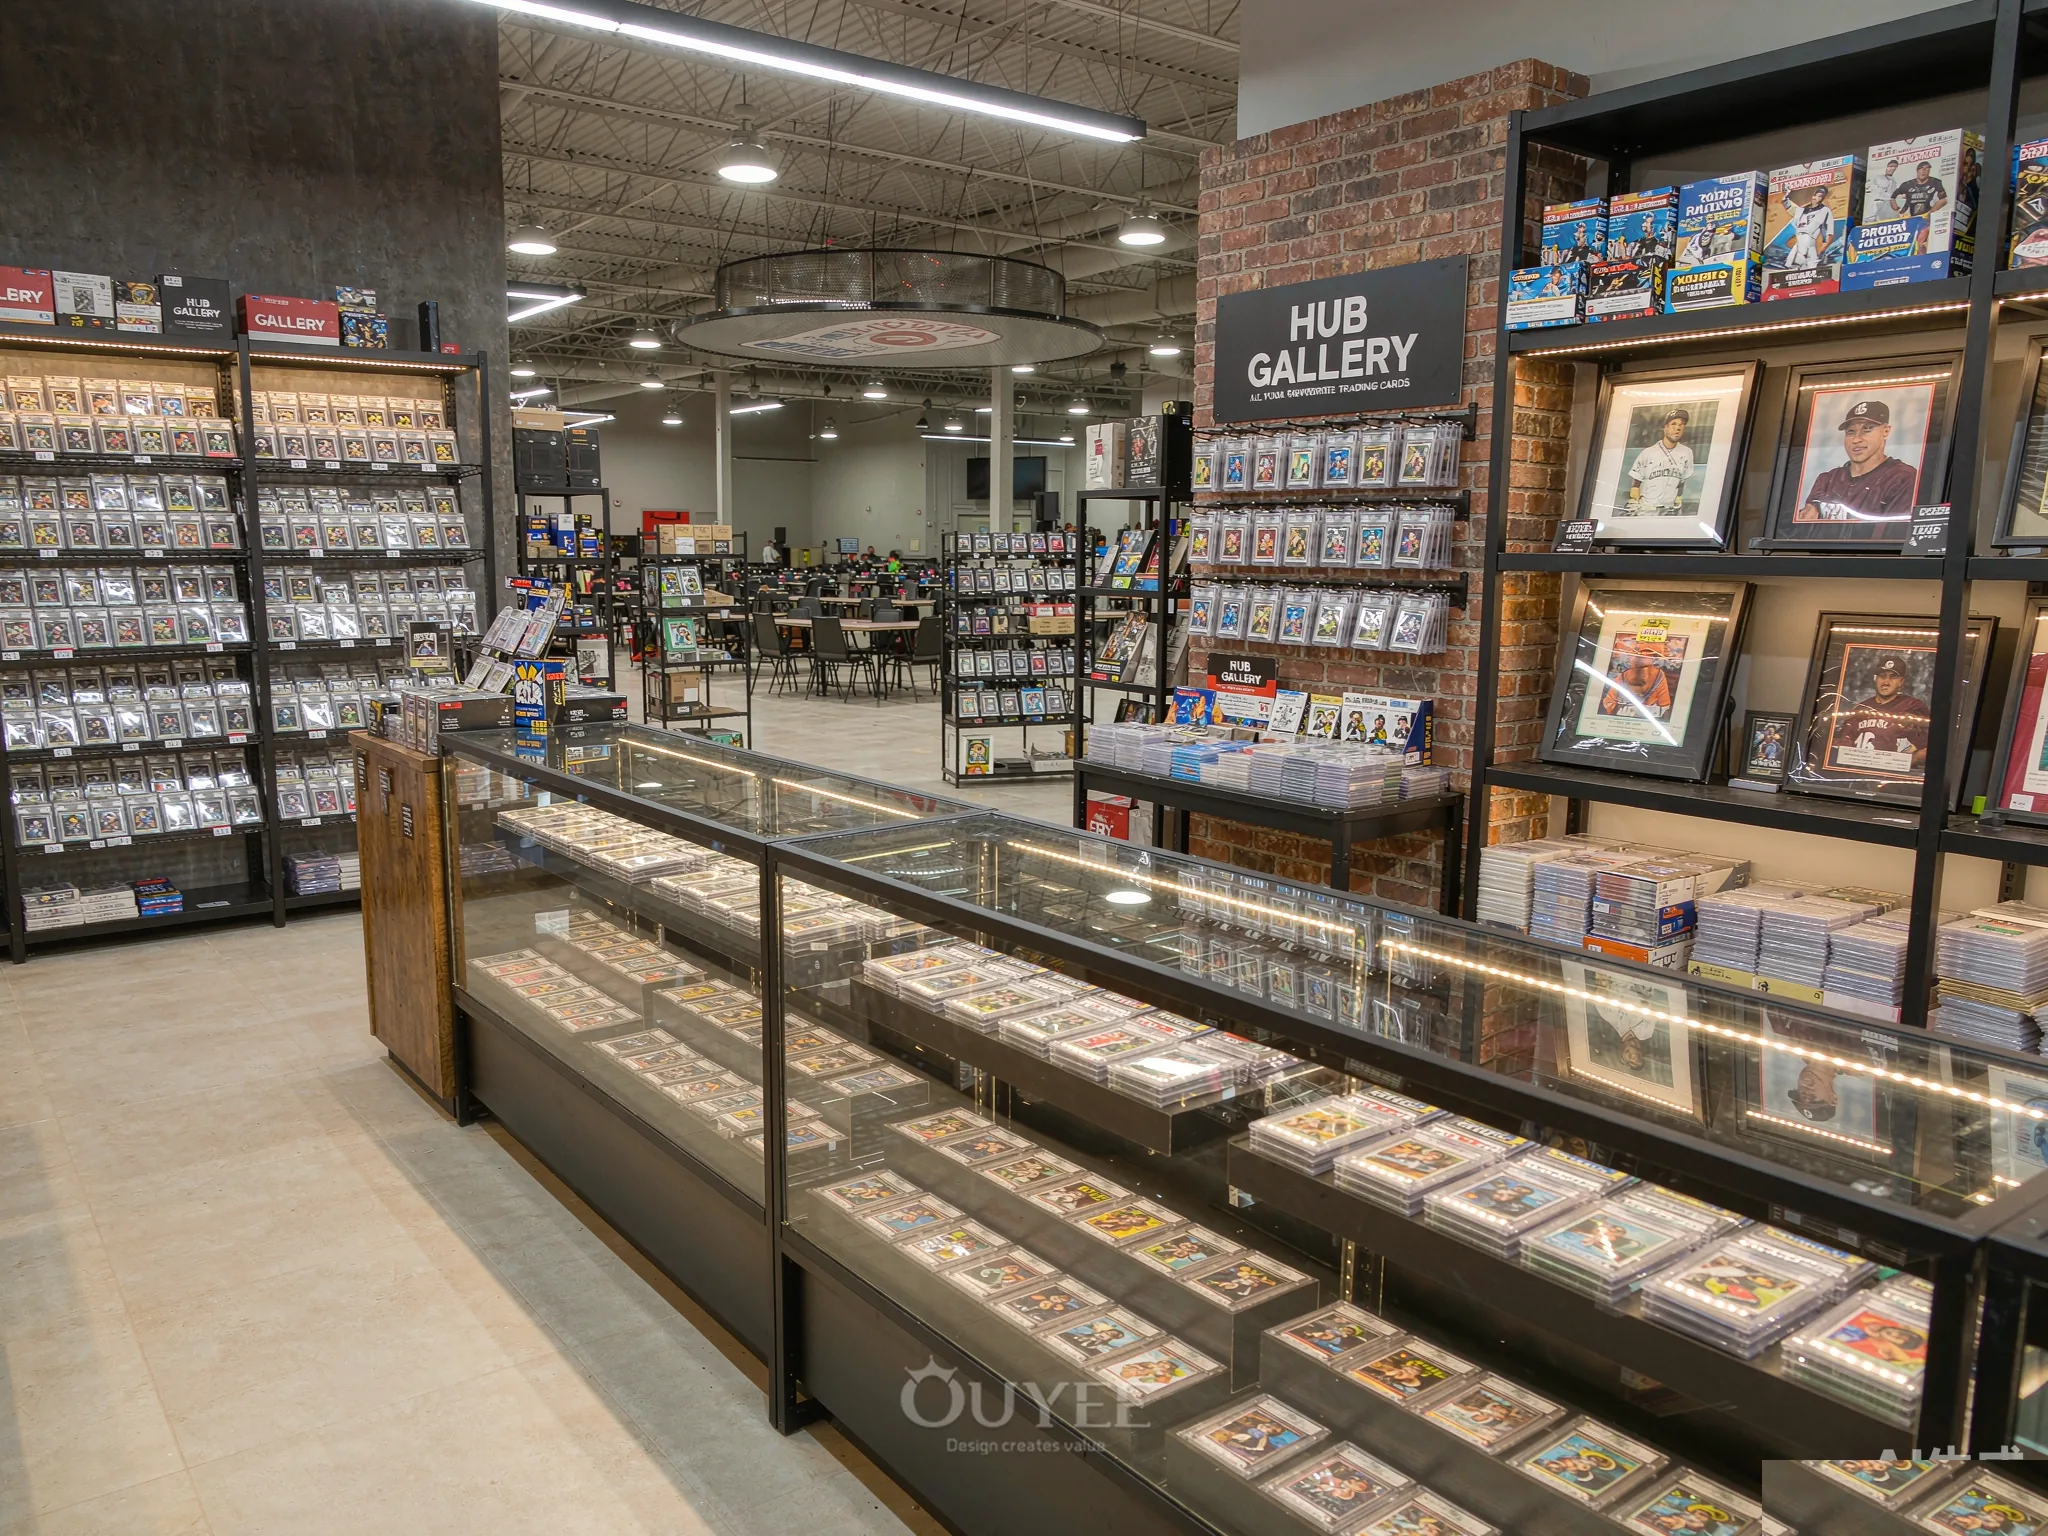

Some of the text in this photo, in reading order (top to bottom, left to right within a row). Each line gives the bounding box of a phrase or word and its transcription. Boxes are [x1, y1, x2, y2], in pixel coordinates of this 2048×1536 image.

[173, 306, 221, 318] GALLERY
[1290, 295, 1368, 342] HUB
[254, 313, 326, 331] GALLERY
[1247, 332, 1419, 388] GALLERY
[1338, 381, 1378, 394] TRADING
[1379, 378, 1411, 390] CARDS
[1221, 671, 1262, 685] GALLERY
